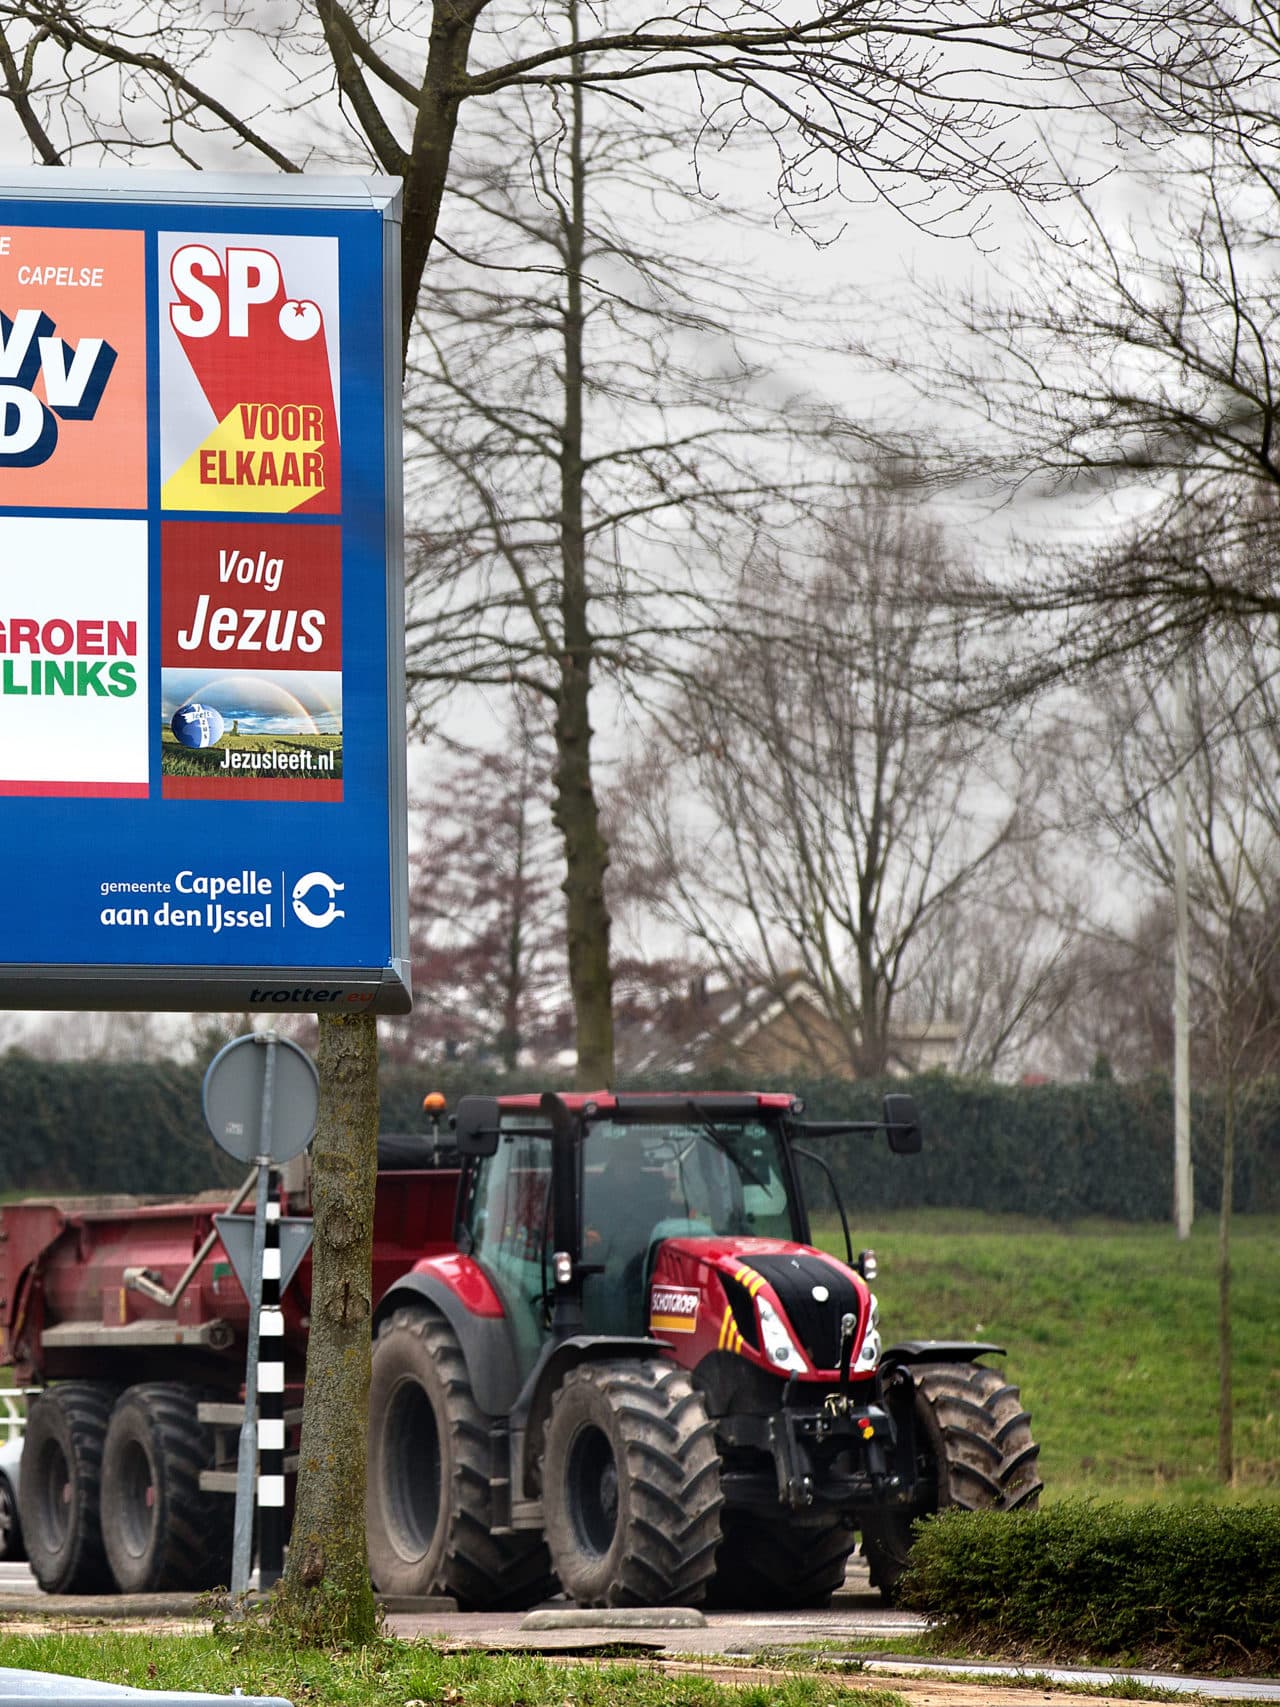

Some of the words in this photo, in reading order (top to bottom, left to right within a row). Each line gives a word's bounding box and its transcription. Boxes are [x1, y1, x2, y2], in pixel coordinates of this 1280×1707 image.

[18, 265, 104, 288] CAPELSE
[239, 404, 325, 442] VOOR
[200, 449, 325, 488] ELKAAR
[219, 550, 285, 592] Volg
[177, 594, 327, 653] Jezus
[2, 659, 138, 698] LINKS
[220, 748, 334, 771] Jezusleeft.nl
[100, 880, 171, 895] gemeente
[175, 871, 272, 900] Capelle
[100, 908, 149, 926] aan
[154, 902, 202, 927] den
[207, 903, 272, 933] IJssel
